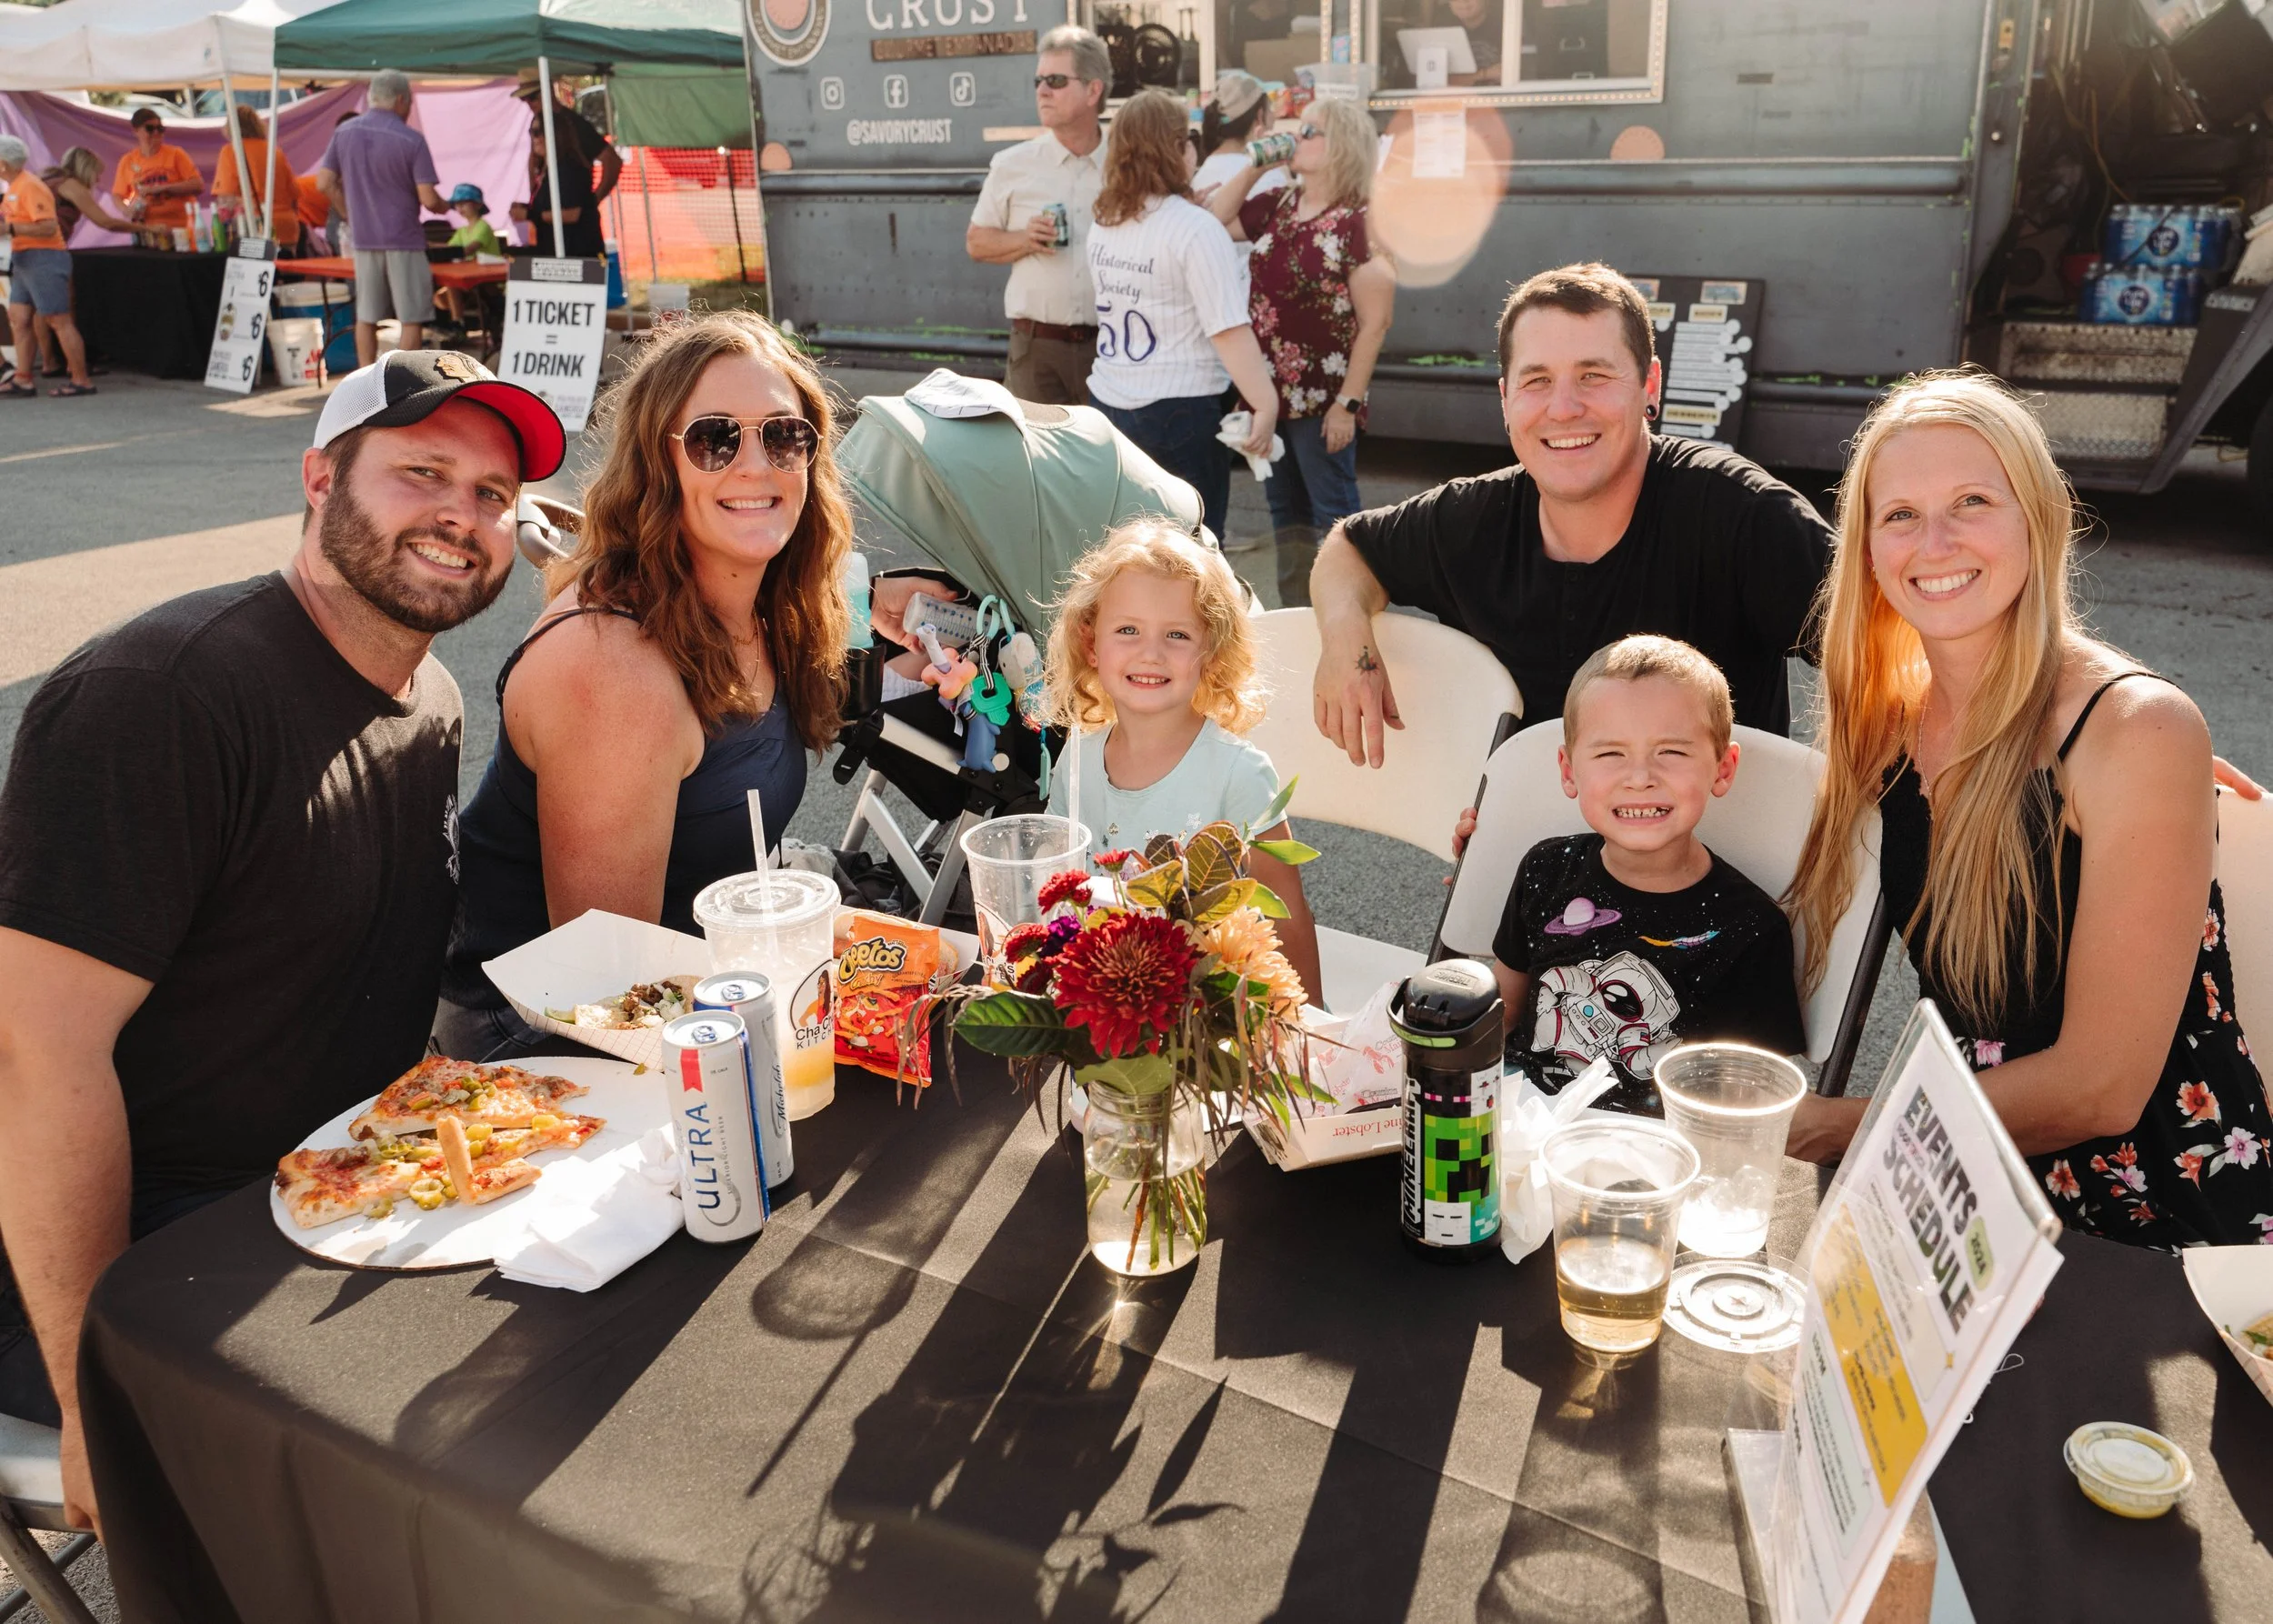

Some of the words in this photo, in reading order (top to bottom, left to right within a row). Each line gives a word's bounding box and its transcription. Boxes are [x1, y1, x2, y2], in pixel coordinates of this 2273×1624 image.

[866, 0, 1028, 30] CRUST
[846, 118, 953, 145] @SAVORYCRUST
[1090, 242, 1155, 275] Historical
[1098, 269, 1141, 305] Society
[514, 299, 521, 323] 1
[526, 300, 596, 327] TICKET
[1096, 305, 1157, 362] 50
[513, 350, 521, 375] 1
[523, 352, 585, 378] DRINK
[796, 1026, 820, 1041] Cha
[796, 1027, 832, 1049] KITCH
[772, 1064, 786, 1126] Michelob
[1333, 1120, 1381, 1138] Lobster
[1384, 1118, 1402, 1129] ine
[685, 1100, 721, 1210] ULTRA
[1903, 1084, 1978, 1235] EVENTS
[1884, 1138, 1975, 1335] SCHEDULE
